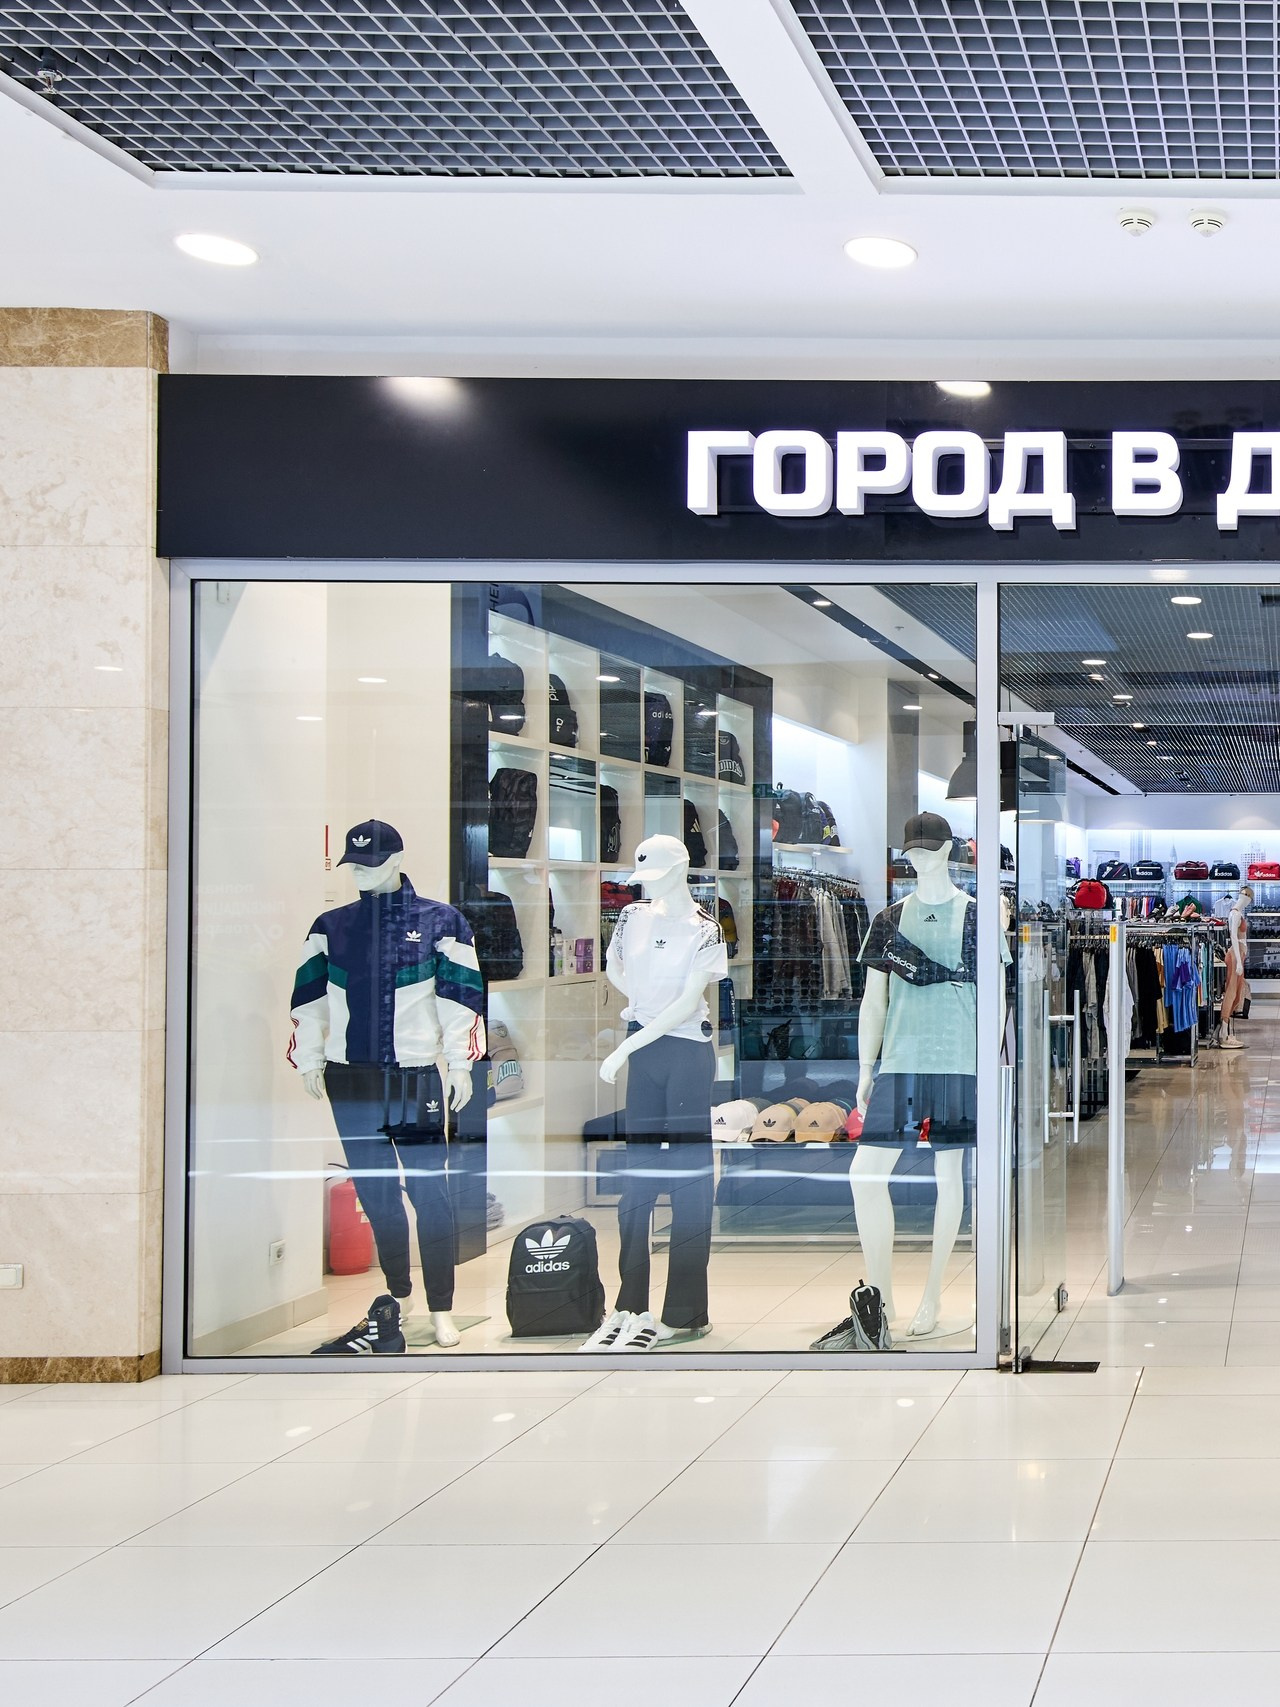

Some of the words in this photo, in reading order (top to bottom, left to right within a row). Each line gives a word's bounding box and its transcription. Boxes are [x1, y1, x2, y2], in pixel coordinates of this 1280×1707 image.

[687, 430, 1076, 531] ГОРОД
[1112, 430, 1183, 517] В
[887, 951, 918, 973] adidas
[525, 1260, 571, 1274] adidas
